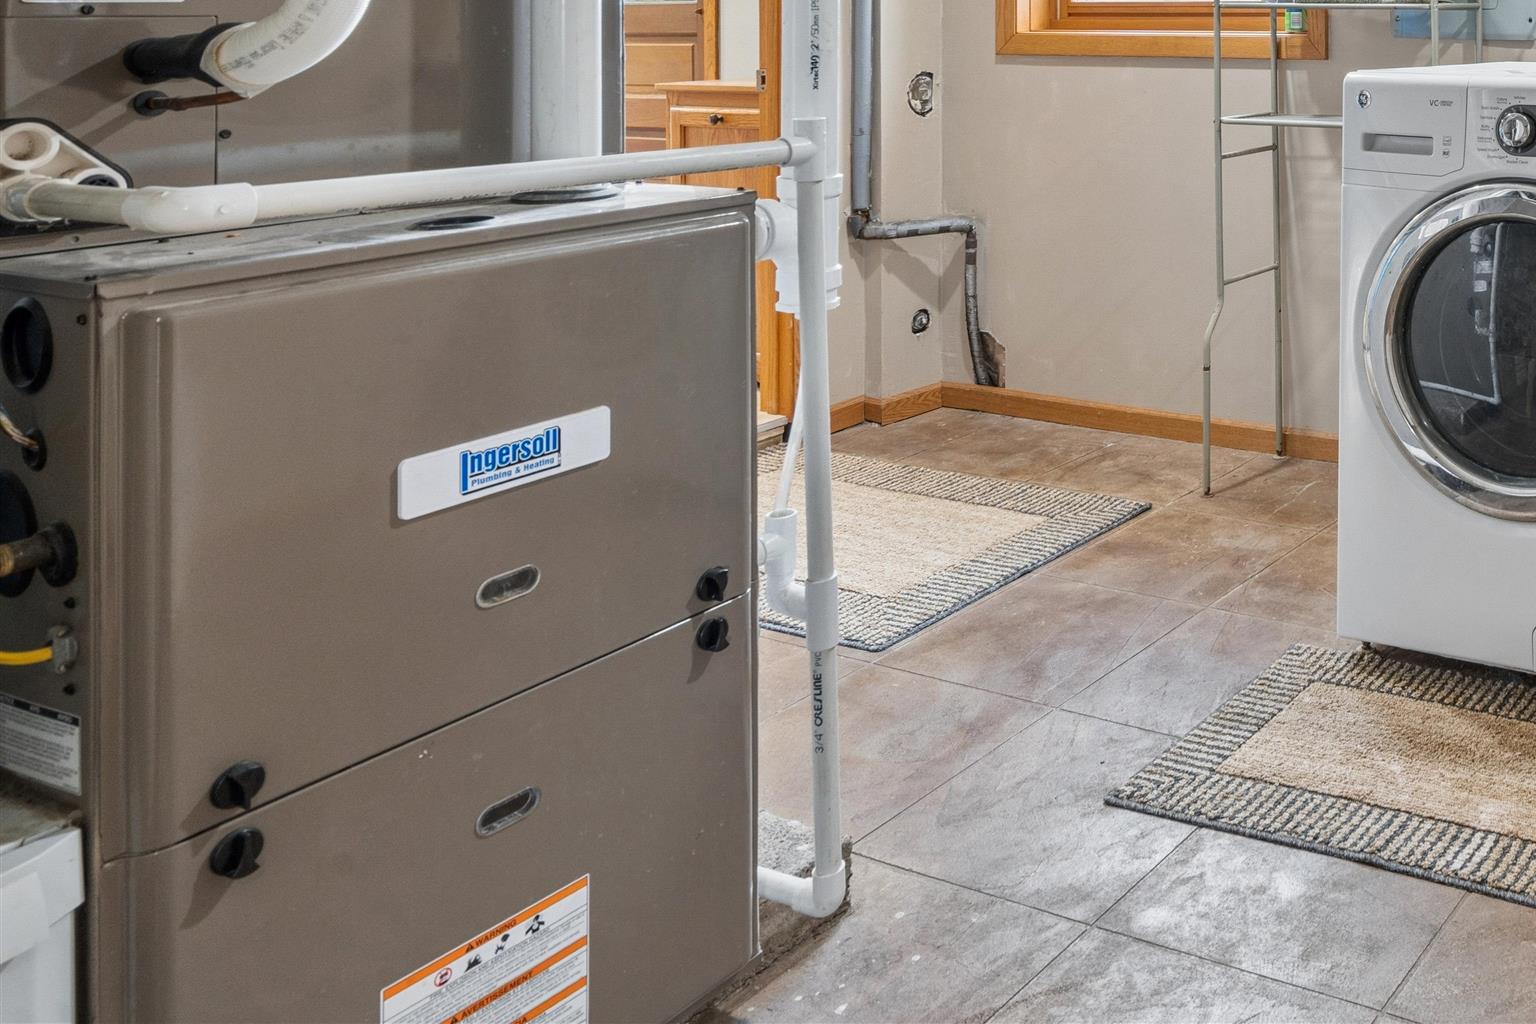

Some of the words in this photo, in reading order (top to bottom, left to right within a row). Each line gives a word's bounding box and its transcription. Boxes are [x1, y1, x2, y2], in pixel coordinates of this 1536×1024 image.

[460, 426, 560, 494] Ingersoll
[471, 468, 512, 487] Plumbing
[514, 465, 521, 474] &
[523, 456, 555, 472] Heating
[812, 673, 824, 727] CRESLINE
[475, 918, 518, 946] WARNING
[460, 970, 534, 1018] AVERTISSEMENT
